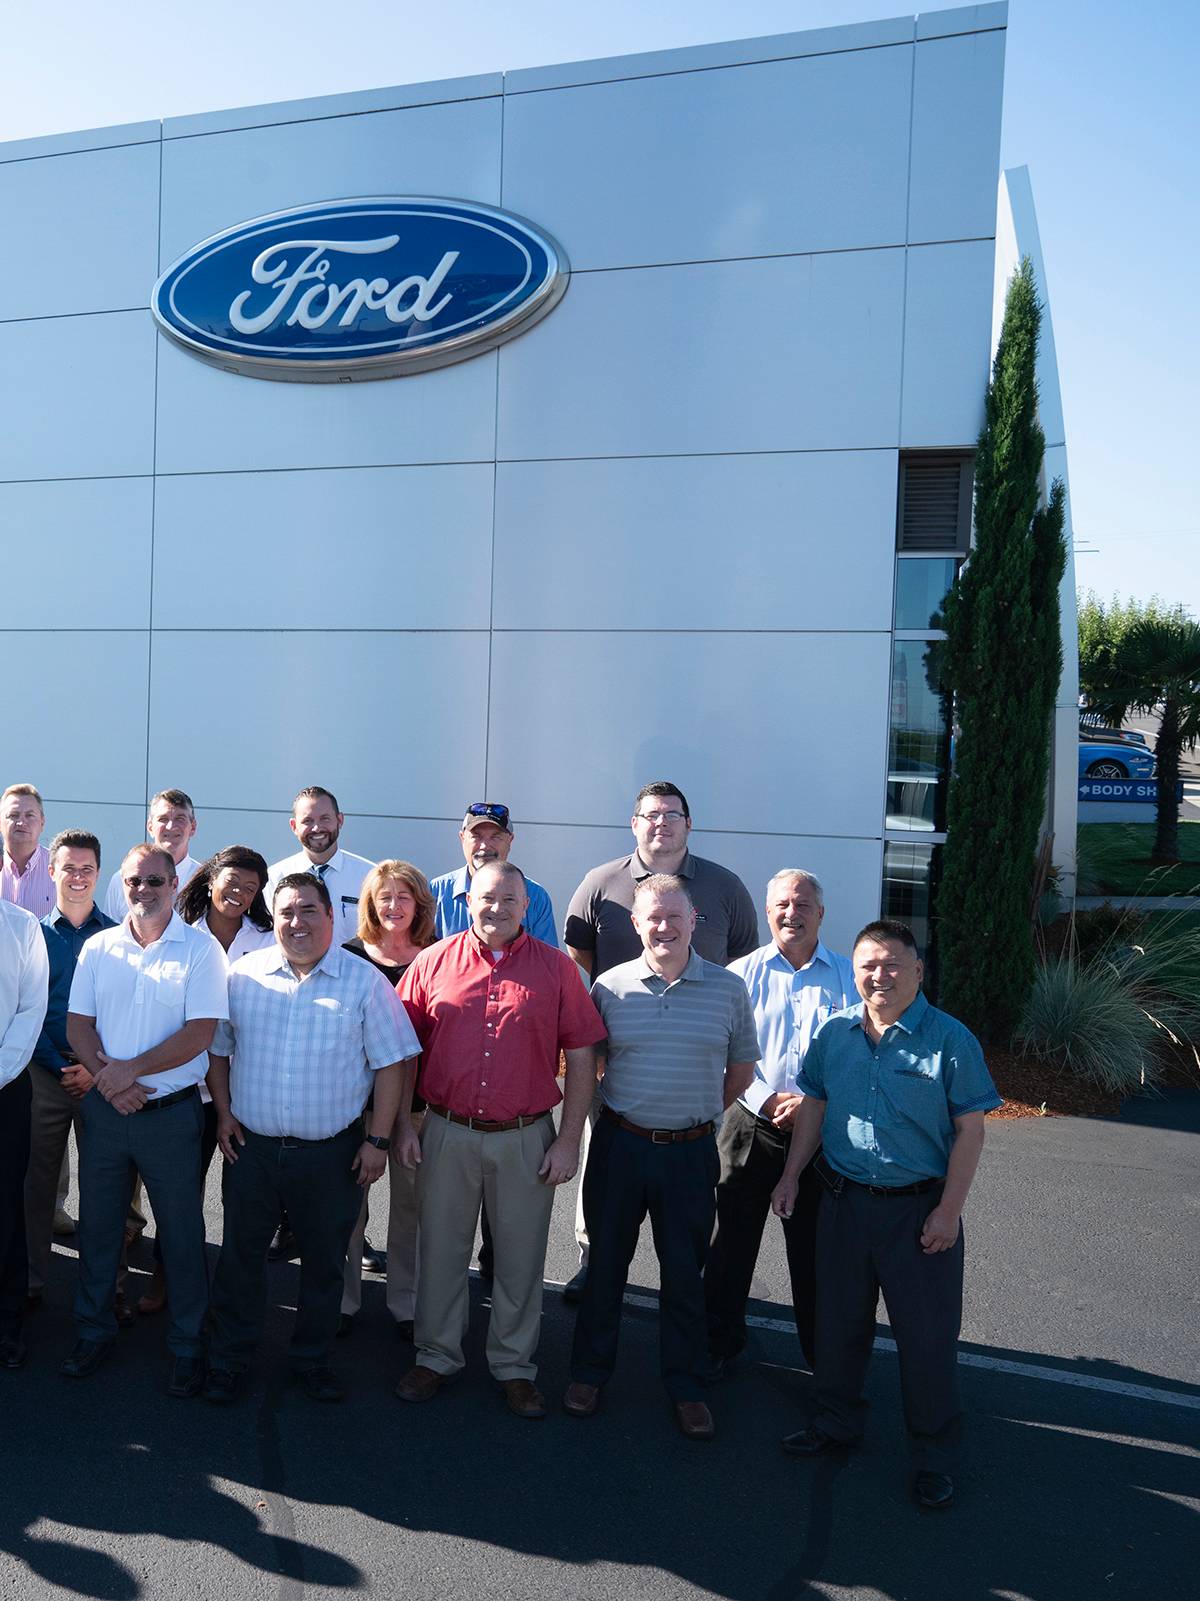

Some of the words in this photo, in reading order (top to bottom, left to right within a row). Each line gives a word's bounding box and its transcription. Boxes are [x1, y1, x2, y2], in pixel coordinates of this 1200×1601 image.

[229, 234, 461, 335] Ford
[1092, 785, 1133, 796] BODY
[1136, 785, 1157, 796] SH
